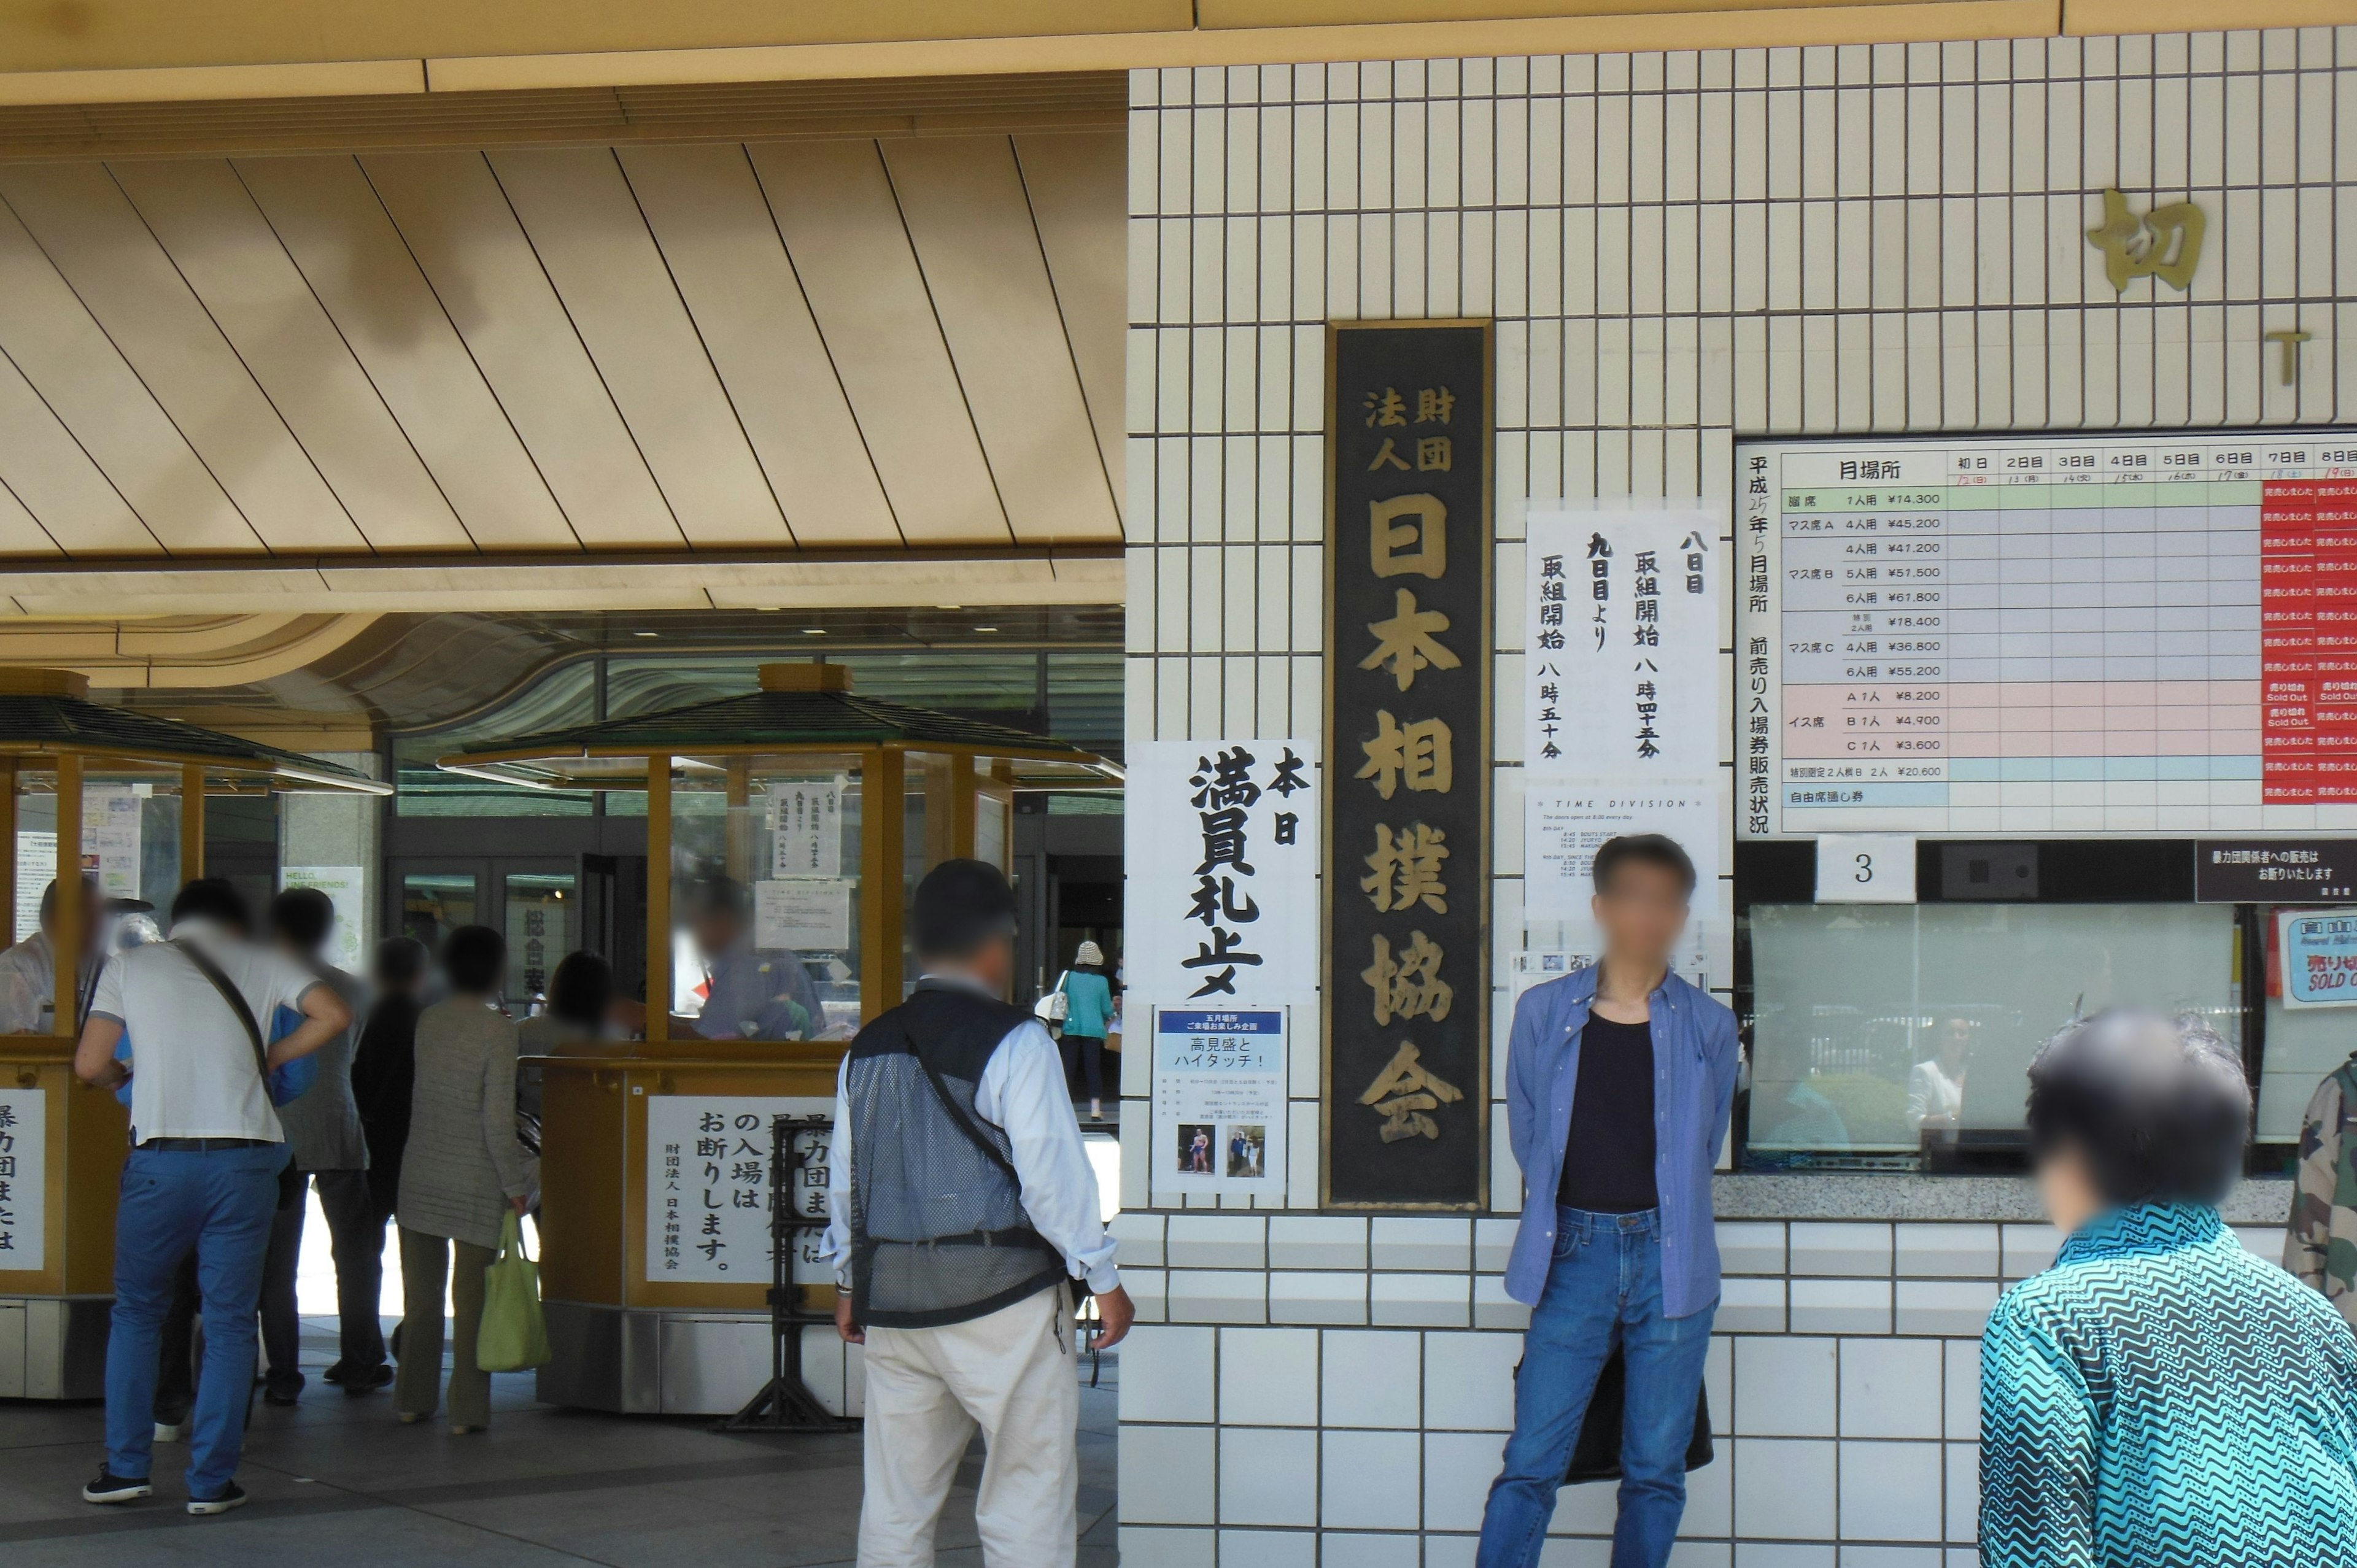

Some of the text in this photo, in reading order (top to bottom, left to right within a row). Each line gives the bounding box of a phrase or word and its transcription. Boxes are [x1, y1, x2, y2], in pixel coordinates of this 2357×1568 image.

[2266, 332, 2312, 387] T
[1362, 387, 1411, 472] 法人
[1414, 385, 1457, 472] 財団
[2007, 456, 2043, 468] 2日目
[2059, 455, 2094, 467] 3日目
[2110, 454, 2147, 466] 4日目
[2163, 453, 2199, 465] 5日目
[2216, 452, 2253, 464] 6日目
[2269, 450, 2305, 463] 7日目
[1840, 460, 1902, 480] 月場所
[1846, 519, 1877, 530] 4人用
[1846, 543, 1877, 555] 4人用
[1680, 530, 1708, 594] 八日目
[1846, 568, 1877, 579] 5人用
[1587, 531, 1614, 652] 九日目より
[1846, 592, 1877, 604] 6人用
[1846, 641, 1877, 653] 4人用
[1536, 554, 1566, 759] 取組開始 八時五十分
[1633, 550, 1660, 760] 取組開始 八時四十五分
[1846, 666, 1877, 678] 6人用
[1789, 716, 1825, 728] イス席
[1749, 636, 1768, 835] 前売り入場券販売状況
[1267, 746, 1311, 845] 本日
[1790, 790, 1864, 803] 自由席通し券
[1353, 493, 1465, 1144] 日本相撲協会
[2213, 851, 2319, 864] 暴力団関係者への販売は
[1855, 854, 1872, 882] 3
[2259, 867, 2333, 881] お断りいたします
[2309, 972, 2346, 992] SOLD
[1187, 1022, 1258, 1031] ご来場お楽しみ企画
[1191, 1037, 1250, 1052] 高見盛と
[730, 1114, 764, 1208] の入場は
[696, 1111, 729, 1271] お断りします。
[664, 1143, 681, 1270] 財団法人 日本相撲協会
